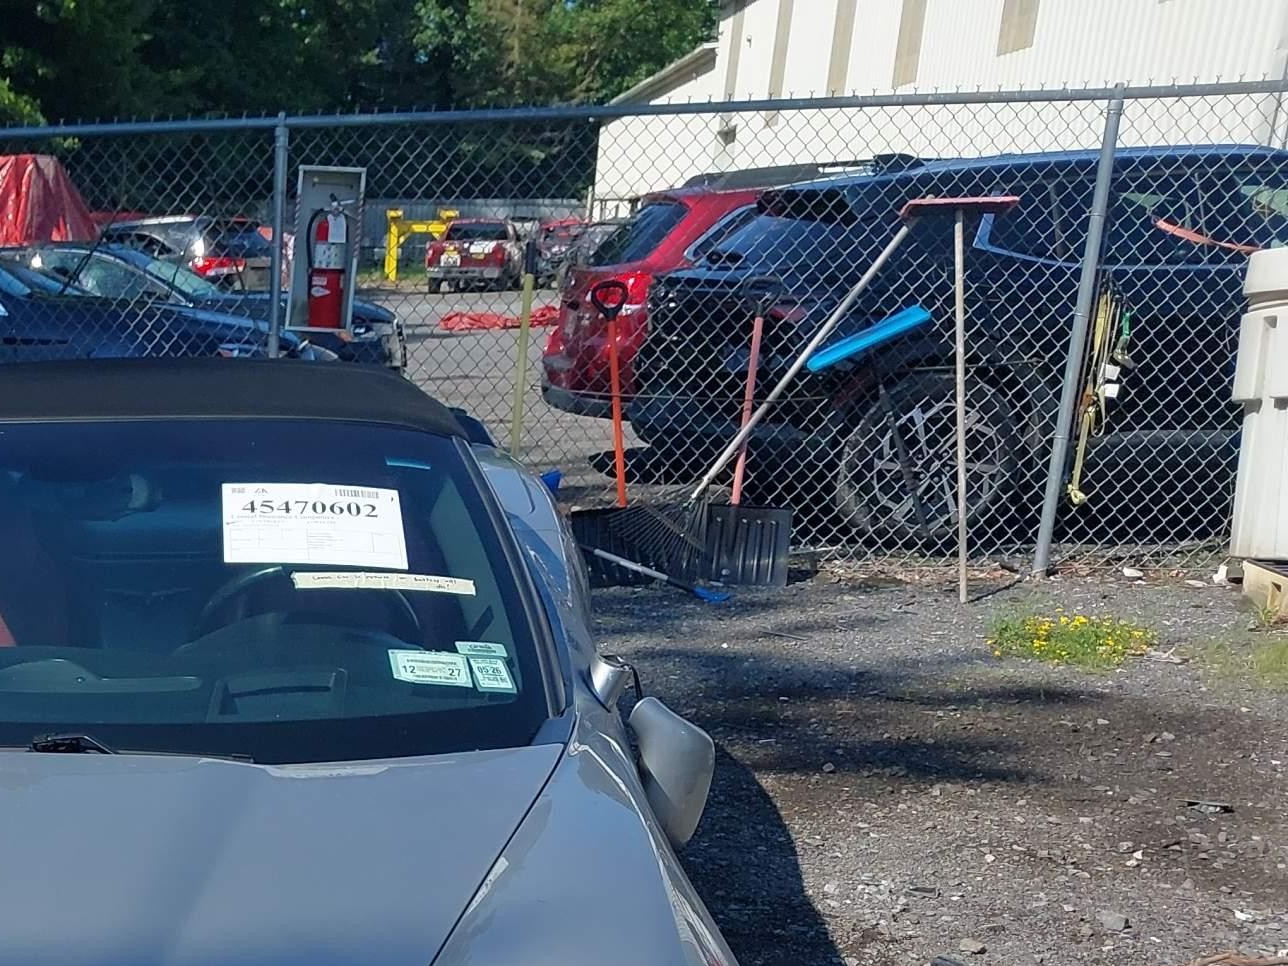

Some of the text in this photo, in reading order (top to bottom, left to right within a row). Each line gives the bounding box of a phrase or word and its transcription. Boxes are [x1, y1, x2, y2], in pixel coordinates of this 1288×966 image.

[241, 499, 379, 518] 45470602
[402, 665, 416, 674] 12
[448, 668, 461, 677] 27
